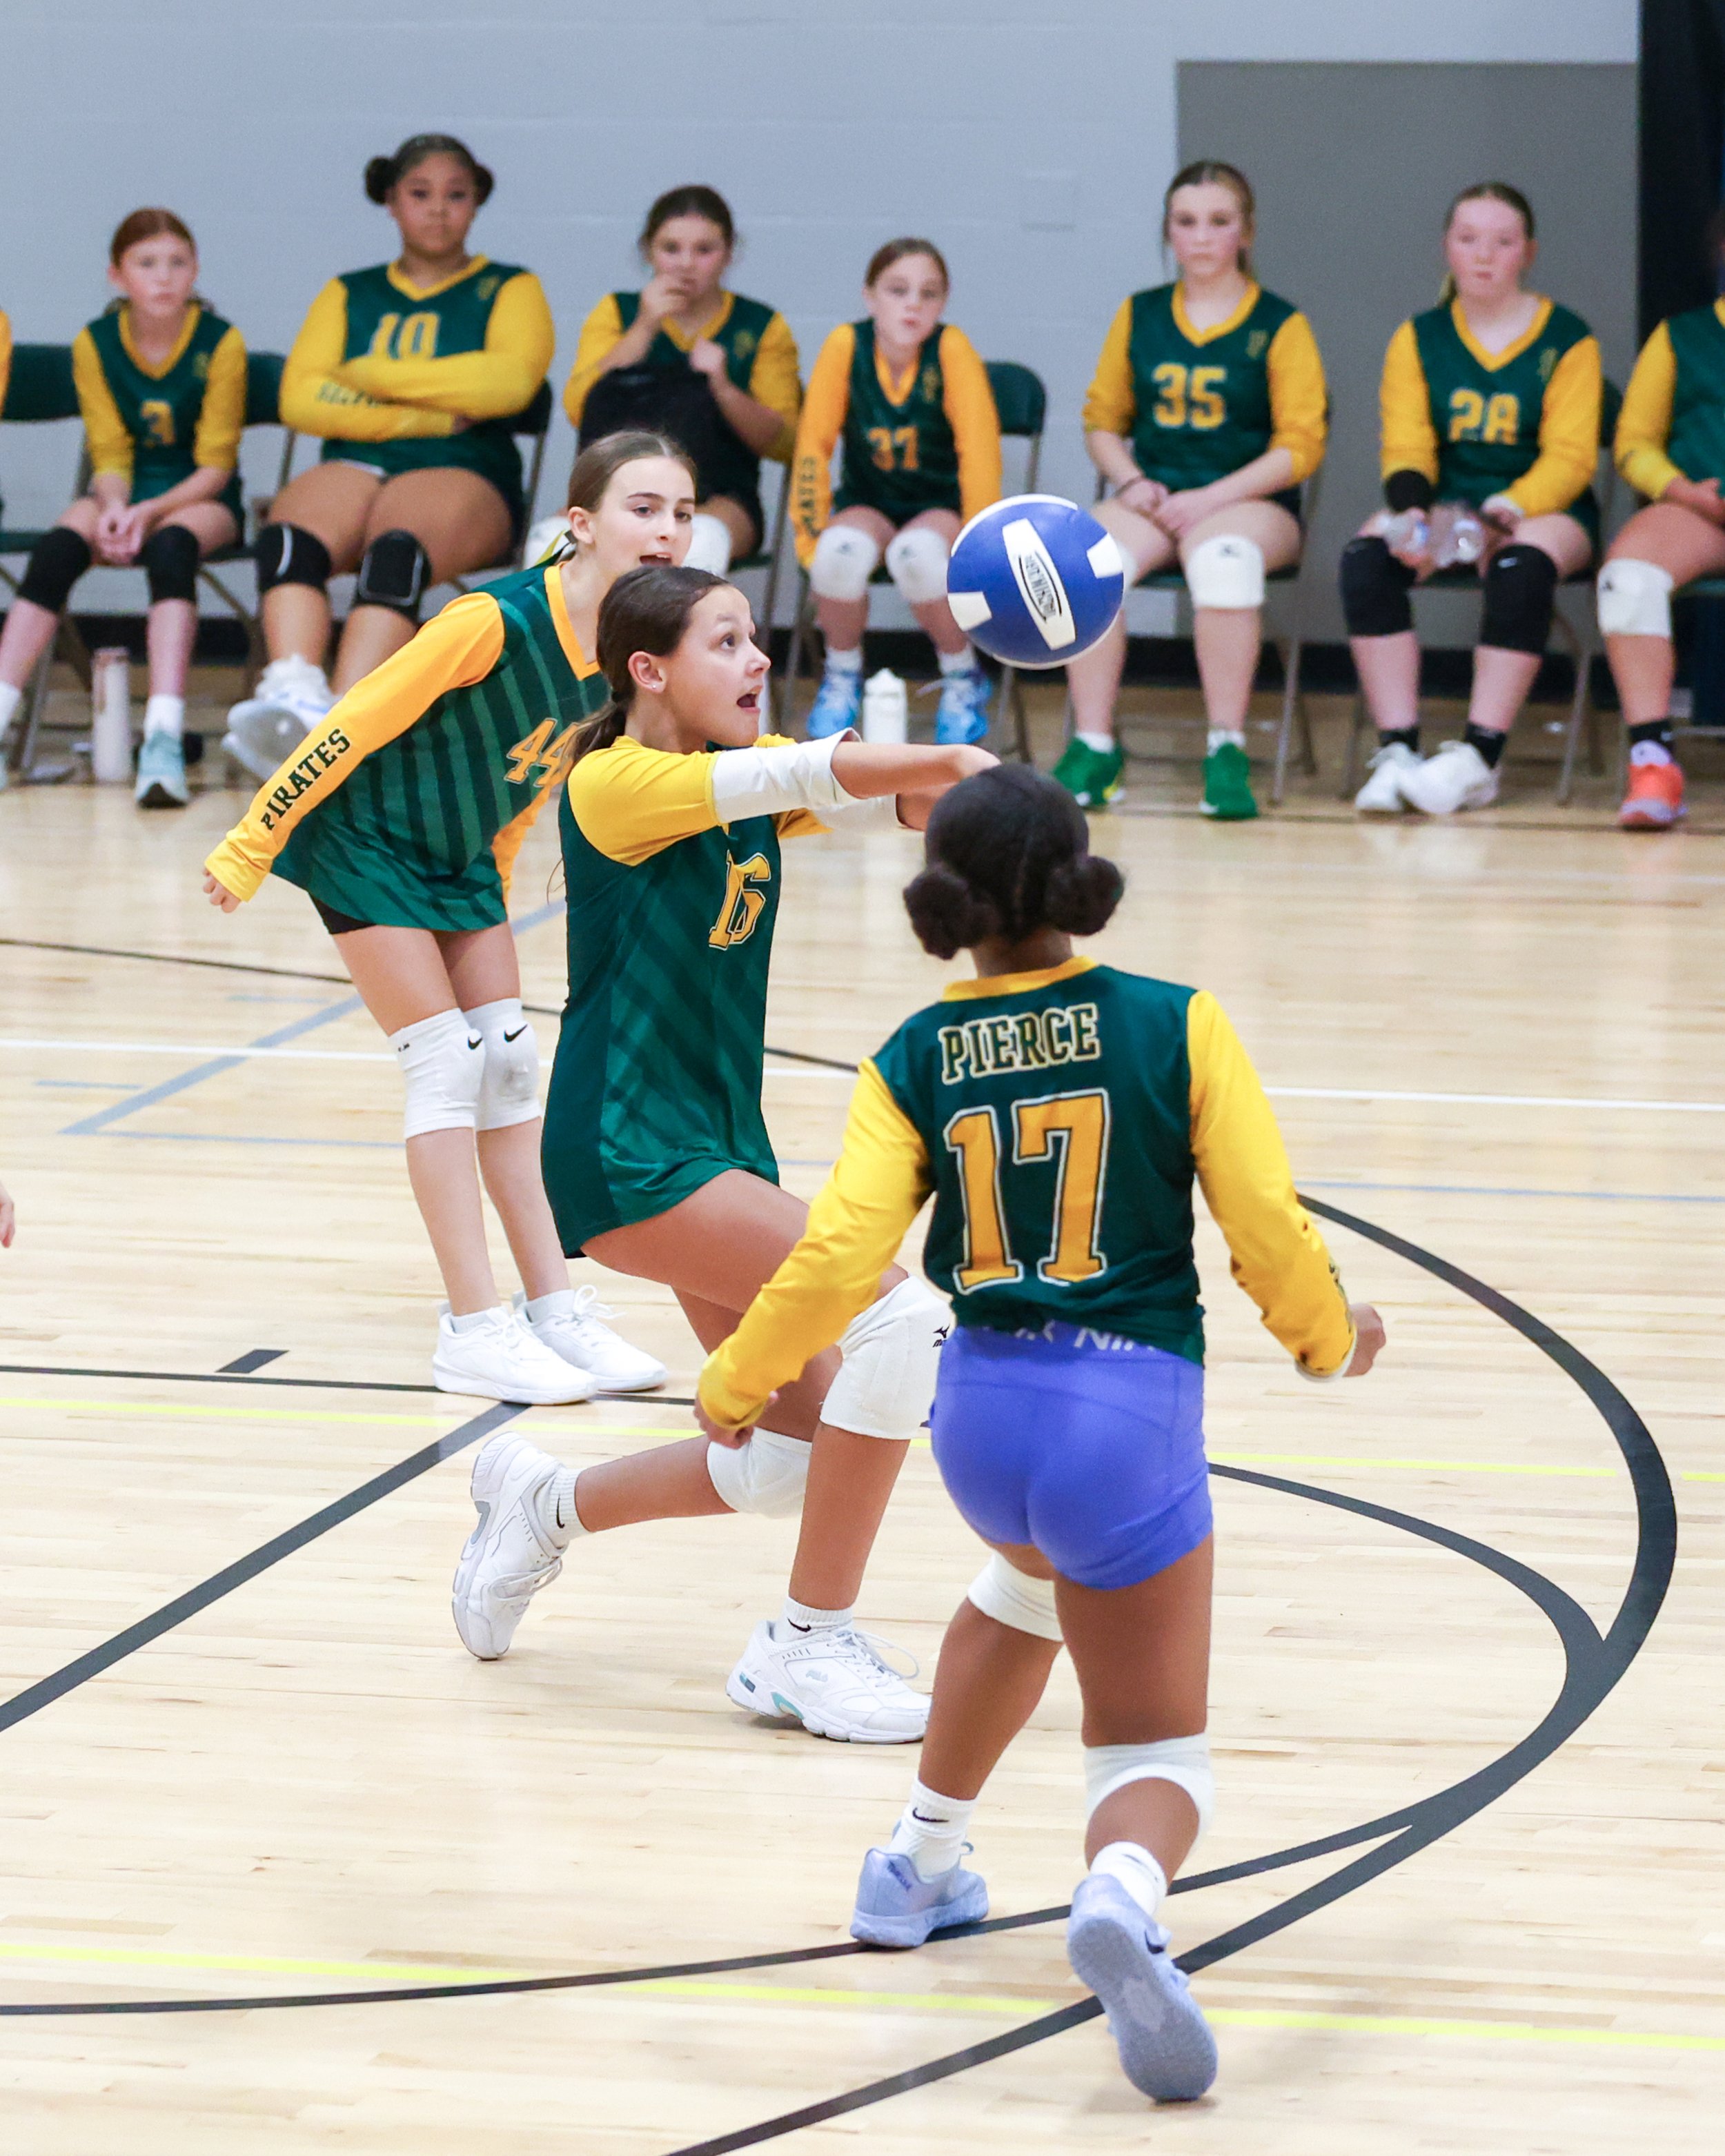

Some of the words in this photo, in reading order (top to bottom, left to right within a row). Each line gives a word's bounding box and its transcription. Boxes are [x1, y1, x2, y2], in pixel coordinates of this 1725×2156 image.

[366, 311, 440, 359] 10
[1151, 362, 1226, 430] 35
[260, 728, 351, 831] PIRATES
[503, 718, 581, 787] 44
[709, 849, 771, 951] 16
[938, 1002, 1102, 1085] PIERCE
[943, 1087, 1111, 1295] 17
